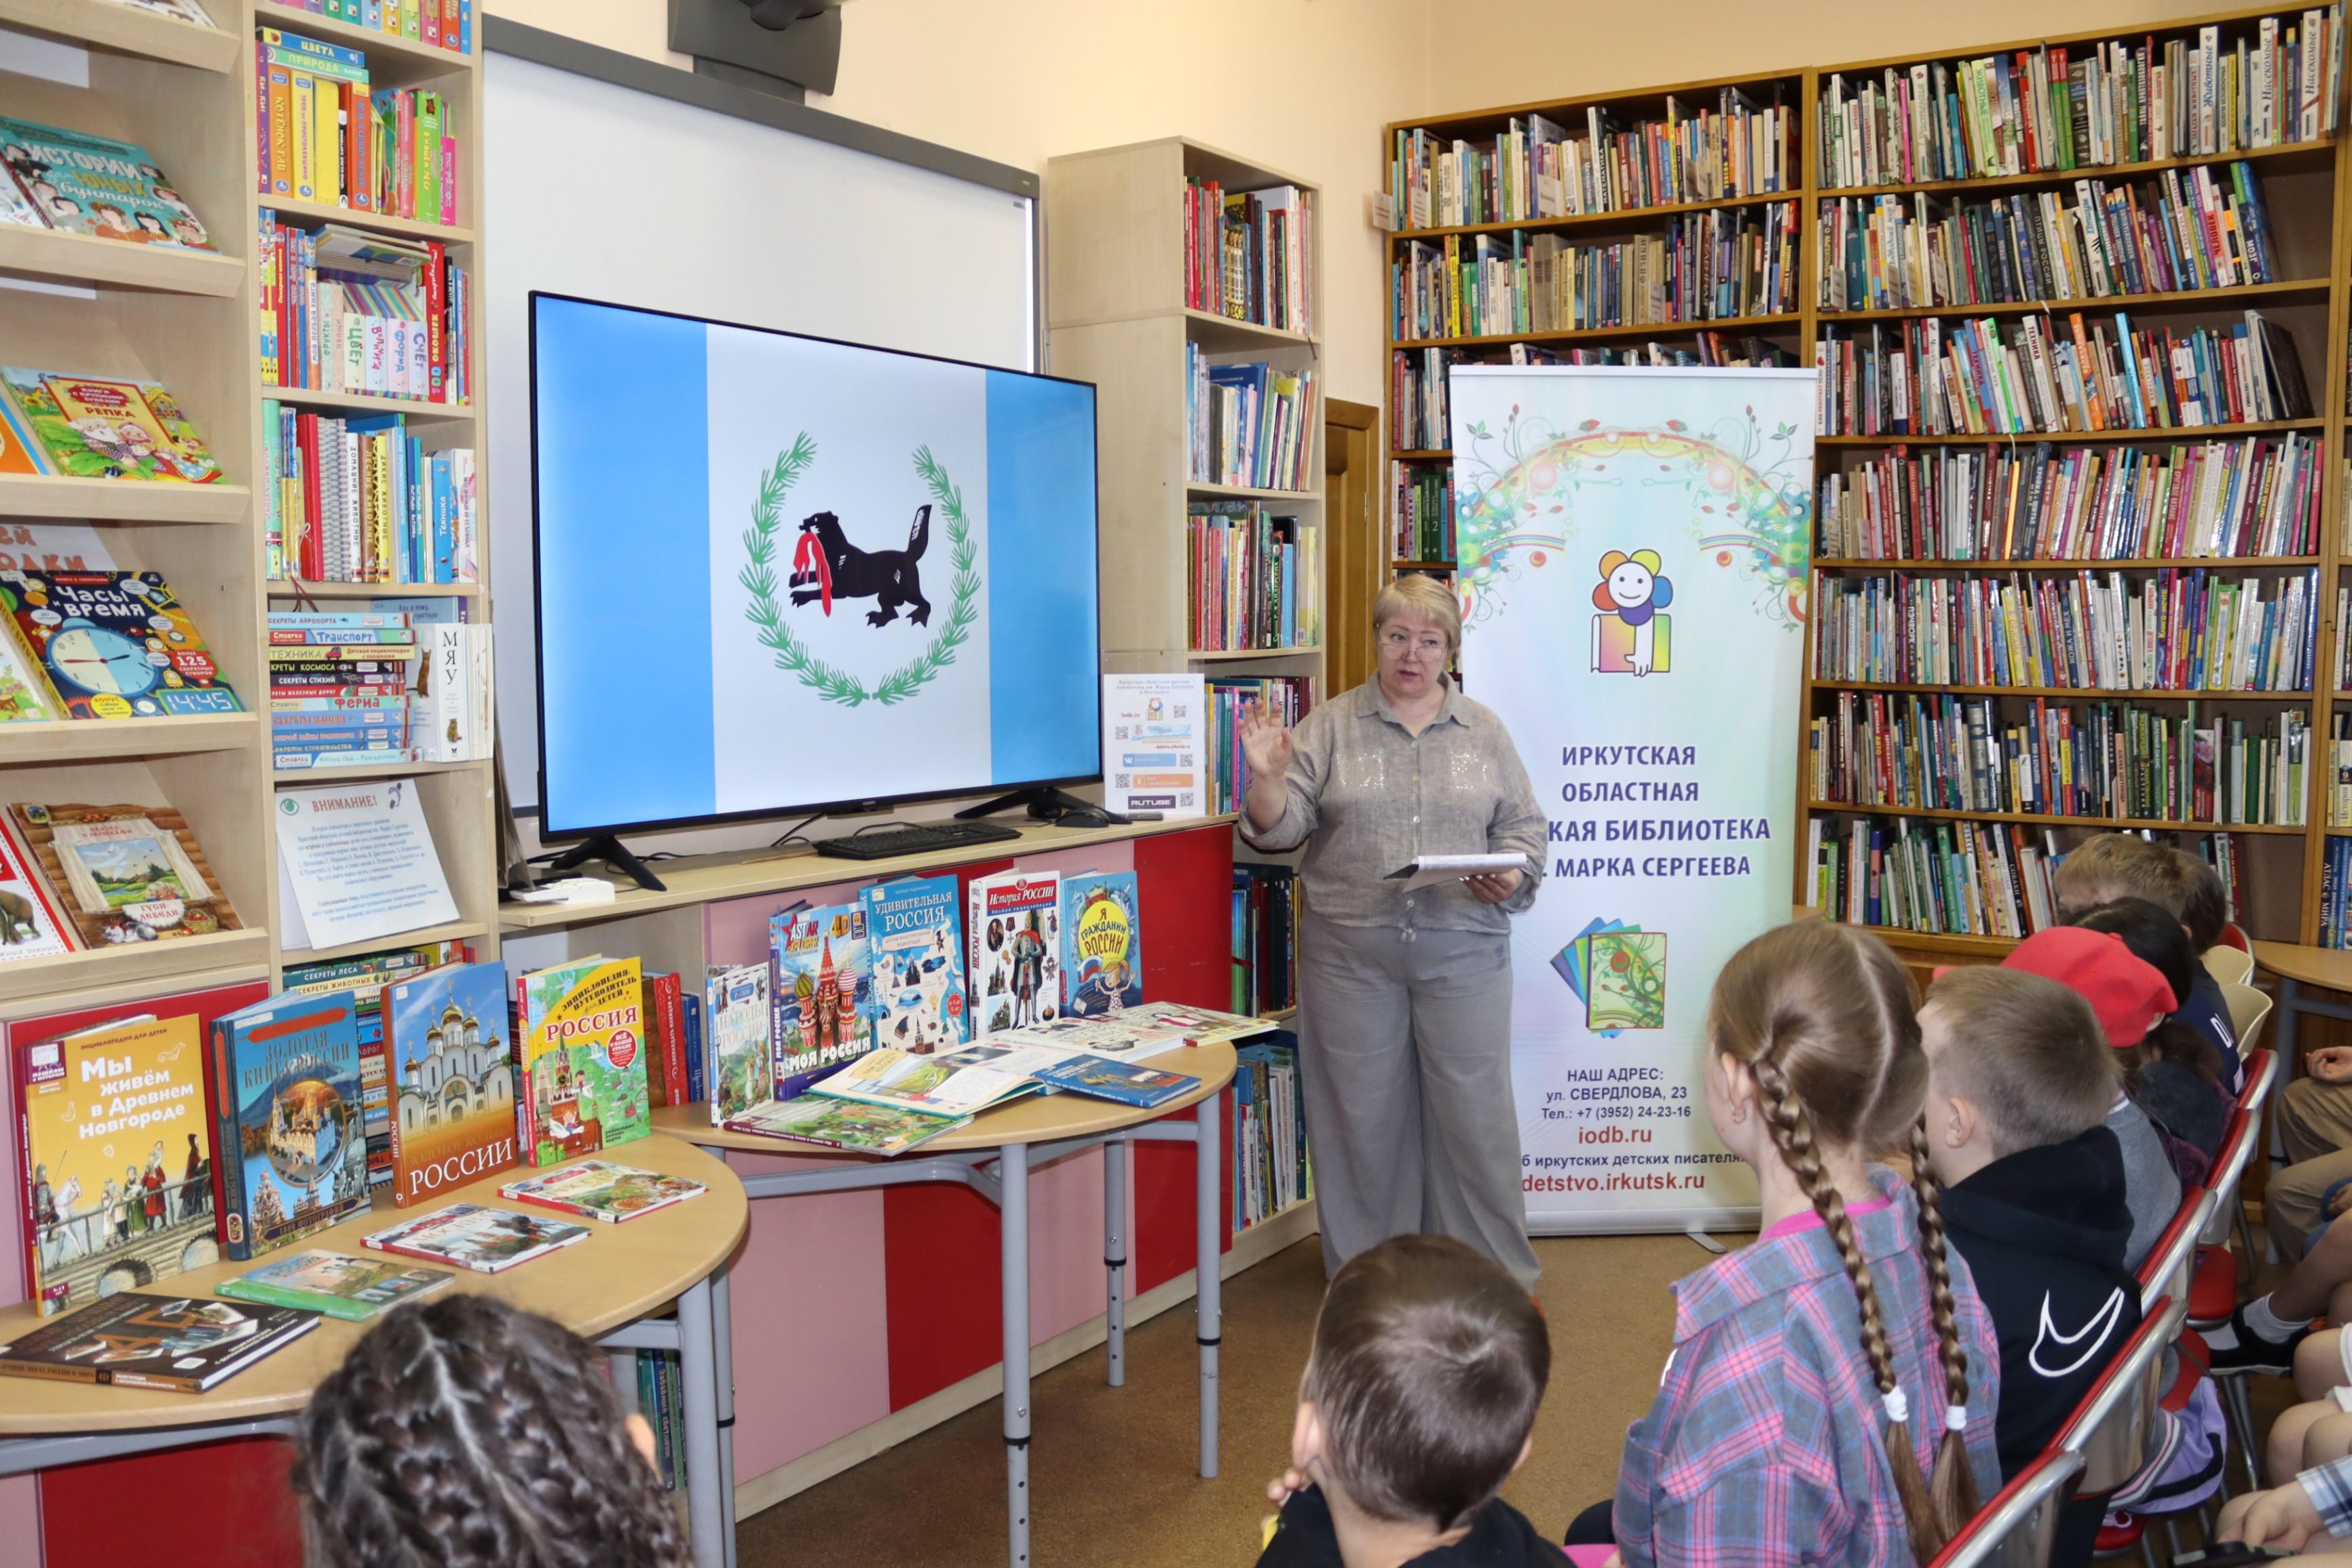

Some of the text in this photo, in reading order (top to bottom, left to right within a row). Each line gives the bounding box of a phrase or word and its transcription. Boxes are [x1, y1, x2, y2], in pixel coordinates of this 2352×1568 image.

[300, 41, 335, 57] ЦВЕТА
[288, 54, 339, 74] ПРИРОДА
[2261, 38, 2273, 101] Насекомые
[2304, 31, 2316, 95] Насекомые
[2203, 45, 2214, 108] Животные
[22, 141, 144, 181] ИСТОРИИ
[276, 149, 286, 172] ГАВ
[1598, 147, 1609, 205] МАТЕМАТИКА
[2207, 213, 2222, 257] ЧЕЛОВЕК
[2034, 215, 2053, 284] ПТИЦЫ РОССИИ
[322, 321, 331, 356] ФРУКТЫ
[432, 314, 441, 362] ОКОШЕК
[2028, 325, 2042, 360] ТЕХНИКА
[1972, 350, 1984, 386] ТЕХНИКА
[84, 407, 136, 418] РЕПКА
[350, 446, 360, 547] ДОМАШНИЕ ЖИВОТНЫЕ
[365, 493, 373, 544] ЖИВОТНЫЕ
[299, 616, 337, 624] АЭРОПОРТА
[1907, 605, 1916, 643] ПЭЧВОРК
[2062, 610, 2072, 629] МЕХ
[2157, 589, 2167, 639] Книга-мечта
[176, 656, 207, 667] 125
[270, 648, 322, 660] ТЕХНИКА
[2066, 637, 2077, 665] КОЖА
[299, 663, 336, 671] КОСМОСА
[1561, 745, 1696, 766] ИРКУТСКАЯ
[2117, 749, 2127, 804] АЗБУКА ЦВЕТОВОДА
[311, 795, 379, 813] ВНИМАНИЕ!
[1130, 798, 1172, 806] RUTUBE
[1561, 781, 1699, 802] ОБЛАСТНАЯ
[1605, 818, 1772, 842] БИБЛИОТЕКА
[1554, 857, 1636, 878] МАРКА
[1642, 855, 1751, 877] СЕРГЕЕВА
[2008, 863, 2022, 896] СОБАКИ
[874, 891, 953, 915] УДИВИТЕЛЬНАЯ
[989, 885, 1055, 906] История РОССИИ
[1012, 901, 1053, 912] энциклопедия
[2320, 862, 2332, 927] АТЛАС МИРА
[139, 910, 179, 920] ЛЕБЕДИ
[829, 914, 851, 939] 4D
[884, 907, 946, 933] РОССИЯ
[1099, 908, 1107, 921] Я
[790, 920, 819, 940] ASTAR
[1081, 920, 1127, 941] ГРАЖДАНИН
[1083, 933, 1124, 956] РОССИИ
[297, 975, 371, 995] СЕКРЕТЫ ЖИВОТНЫХ
[303, 965, 359, 981] СЕКРЕТЫ ЛЕСА
[561, 969, 631, 1013] ЭНЦИКЛОПЕДИЯ-
[572, 977, 637, 1011] ПУТЕВОДИТЕЛЬ
[597, 989, 624, 1007] ДЕТЕЙ
[545, 1007, 638, 1043] РОССИЯ
[773, 1006, 781, 1039] РОССИЯ
[80, 1027, 168, 1051] ЭНЦИКЛОПЕДИЯ ДЛЯ ДЕТЕЙ
[263, 1030, 329, 1058] ЗОЛОТАЯ
[295, 1043, 351, 1075] РОССИИ
[789, 1035, 872, 1072] МОЯ РОССИЯ
[80, 1056, 132, 1083] Мы
[1567, 1067, 1664, 1083] НАШ АДРЕС:
[99, 1069, 170, 1096] живём
[1546, 1086, 1688, 1104] ул. СВЕРДЛОВА, 23
[91, 1083, 195, 1117] в Древнем
[79, 1104, 186, 1140] Новгороде
[1541, 1105, 1692, 1121] Тел.: +7 (3952) 24-23-16
[390, 1121, 400, 1158] РОССИИ
[1578, 1125, 1653, 1144] iodb.ru
[409, 1137, 513, 1195] РОССИИ
[1535, 1154, 1609, 1170] иркутских
[1612, 1153, 1670, 1169] детских
[1674, 1152, 1749, 1165] писателя
[1521, 1172, 1706, 1193] detstvo.irkutsk.ru
